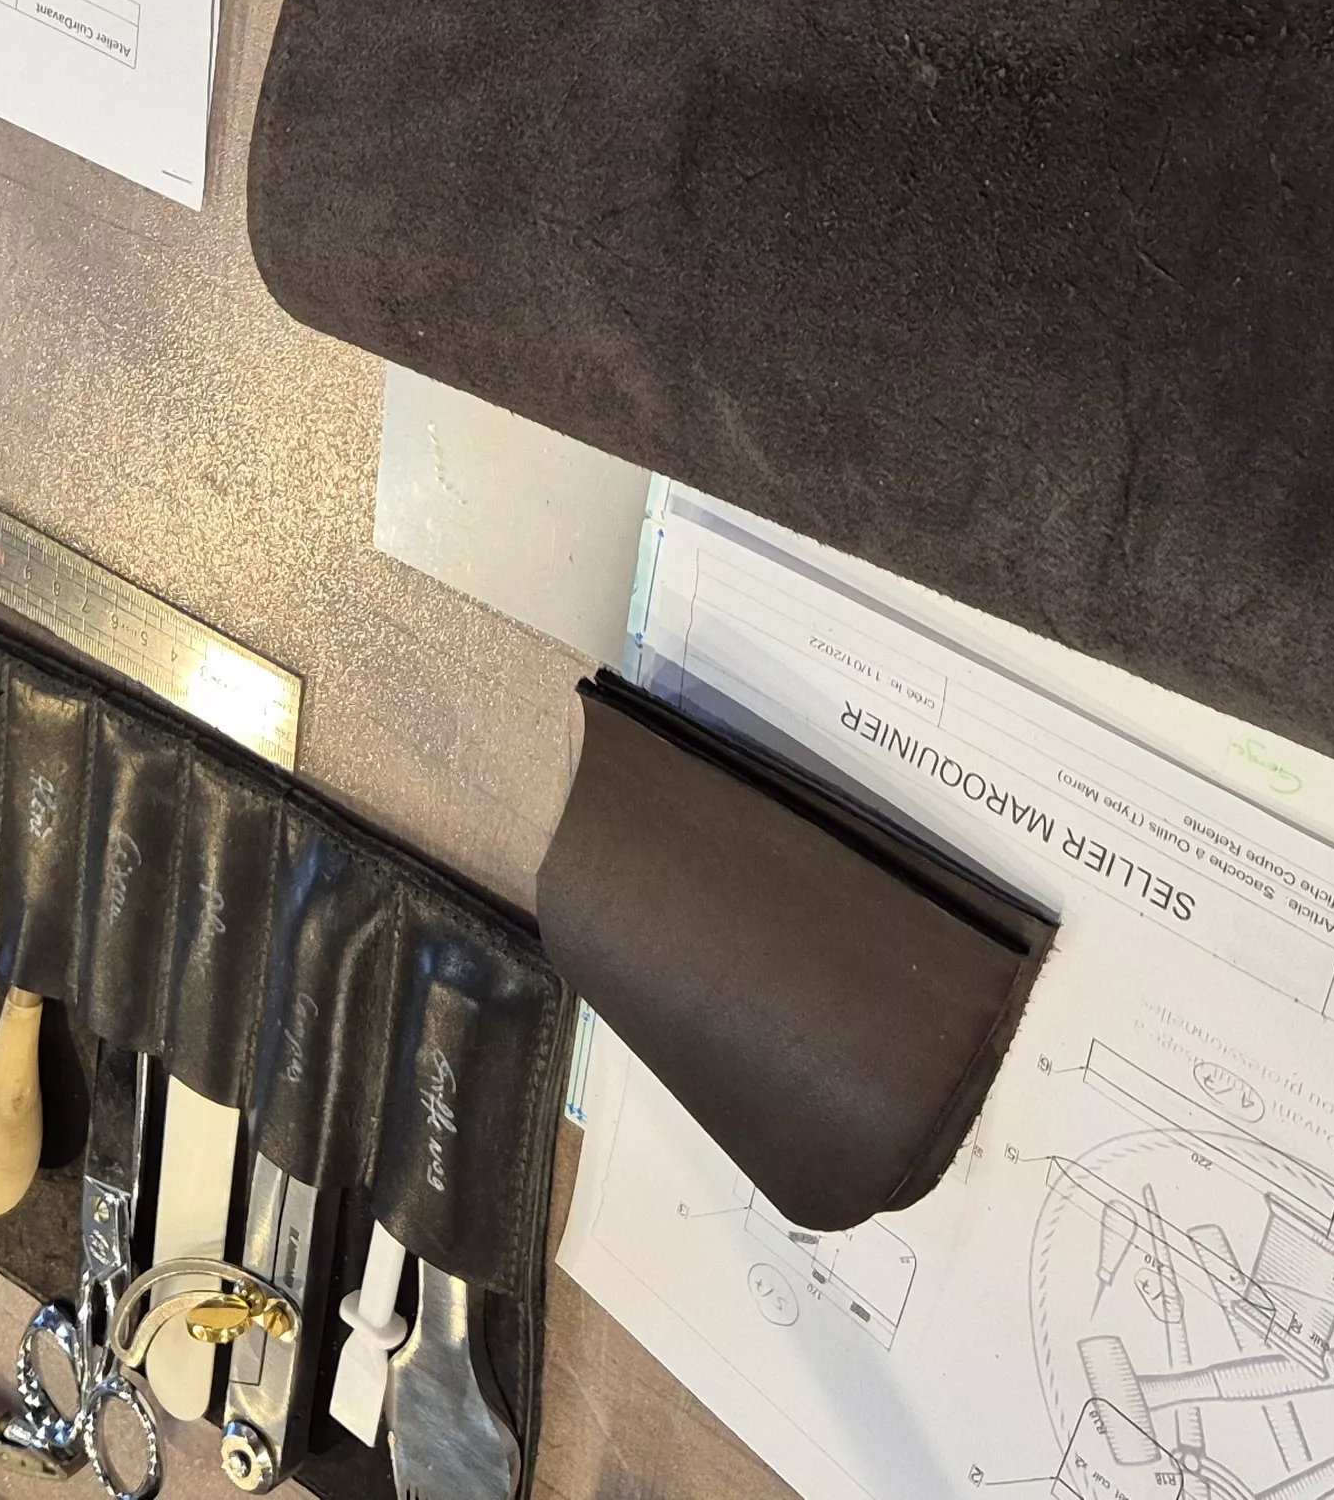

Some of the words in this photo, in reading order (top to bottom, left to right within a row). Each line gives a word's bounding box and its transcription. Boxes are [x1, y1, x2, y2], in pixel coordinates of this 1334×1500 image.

[35, 2, 94, 40] CuirDavant
[95, 31, 132, 58] Atelier
[840, 700, 1056, 844] MAROQUINIER
[1057, 768, 1100, 803] Maro)
[1102, 795, 1145, 828] (Type
[1148, 821, 1191, 854] Outils
[1182, 815, 1242, 858] Refente
[1194, 846, 1206, 861] à
[1061, 826, 1196, 922] SELLIER
[1208, 854, 1277, 901] Sacoche
[1245, 849, 1297, 887] Coupe
